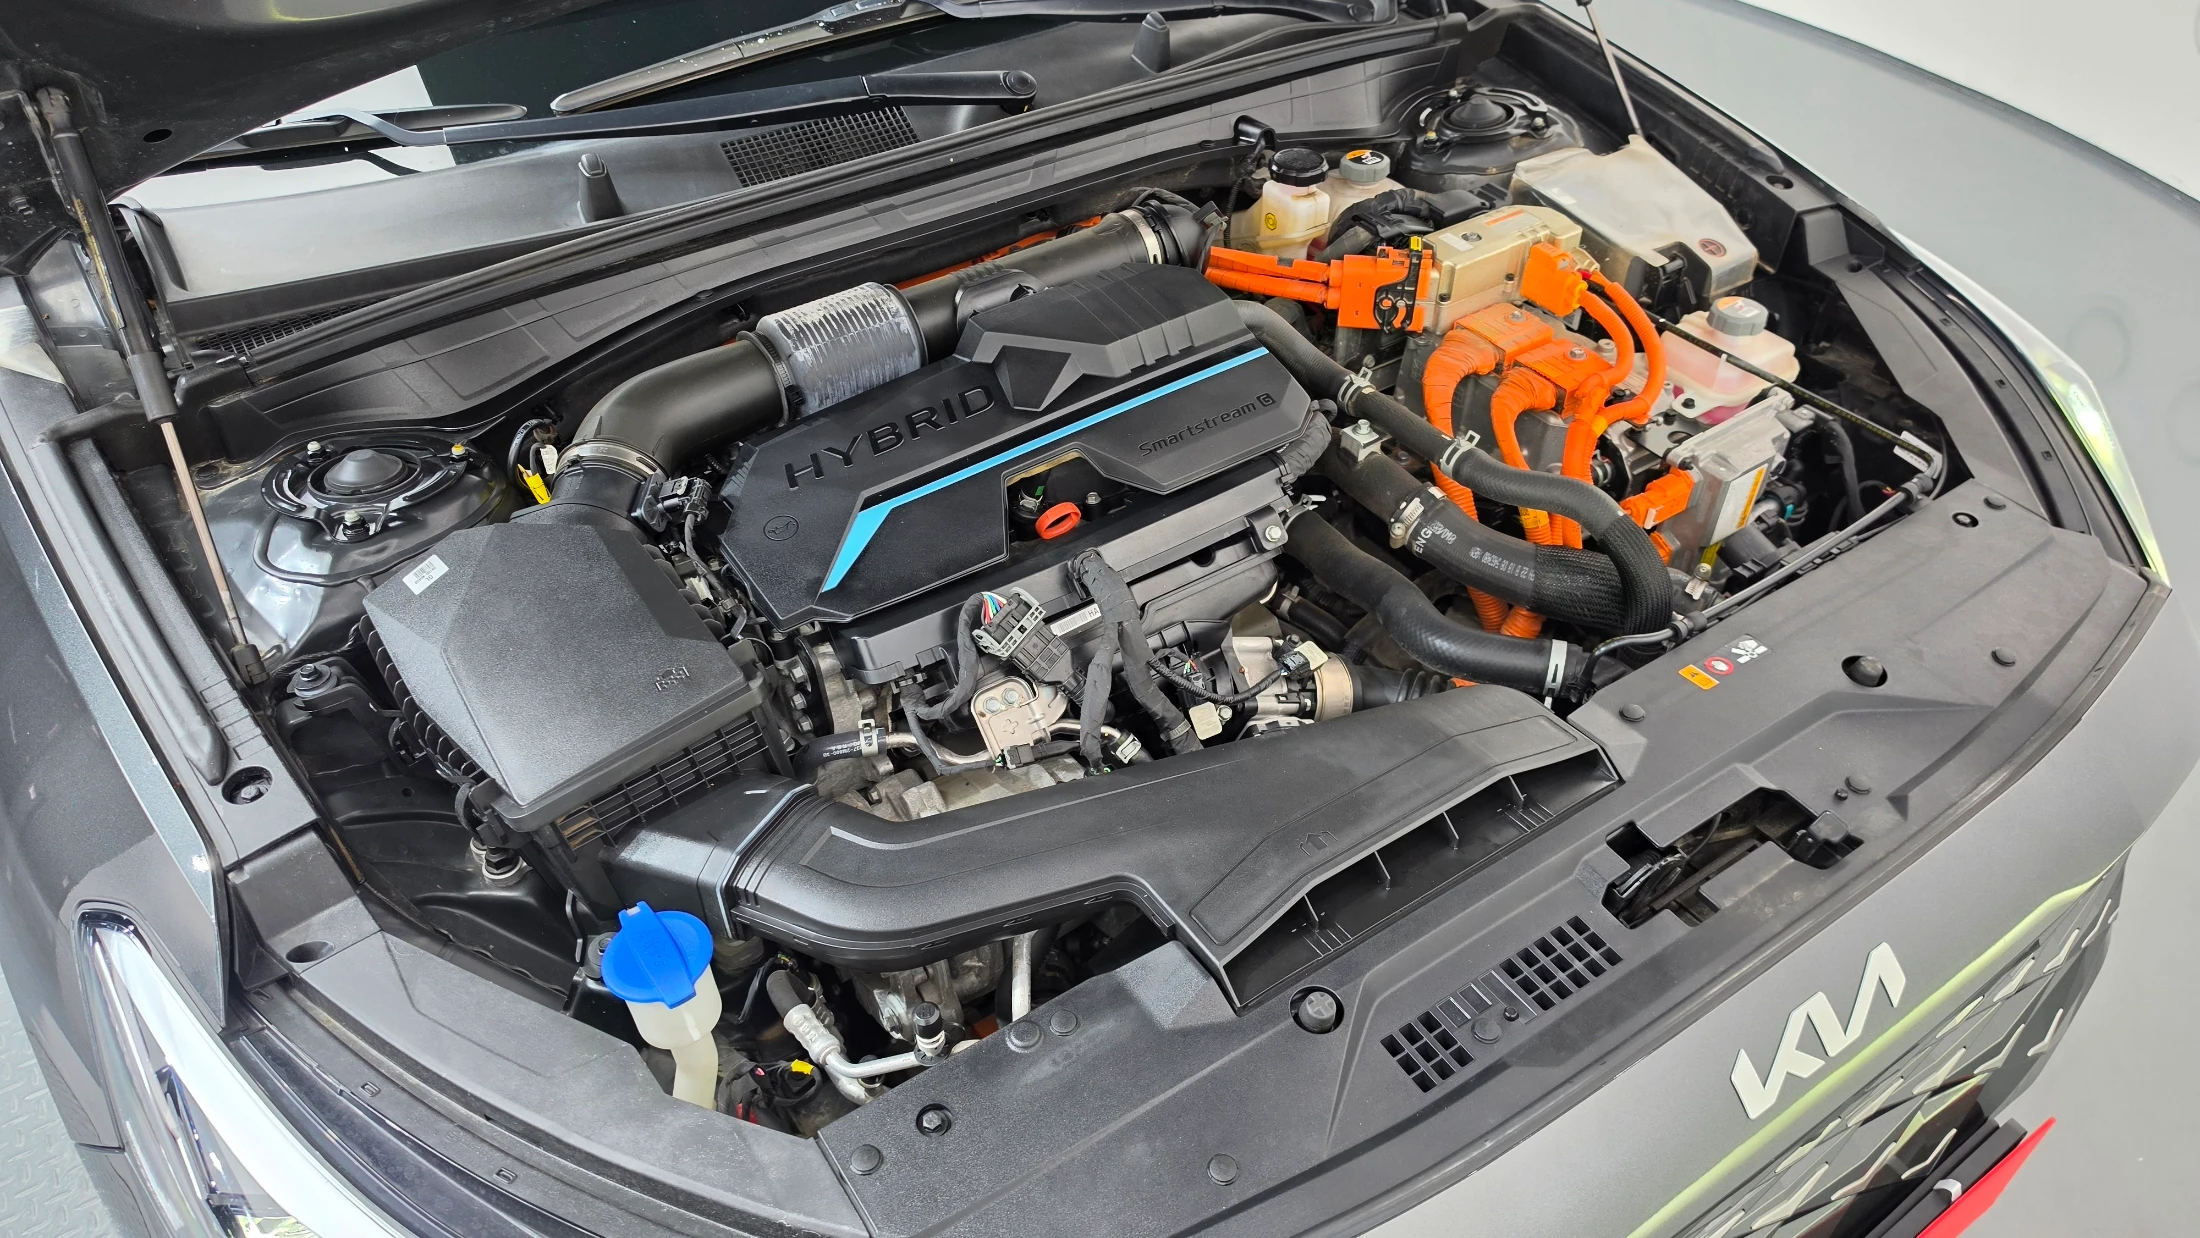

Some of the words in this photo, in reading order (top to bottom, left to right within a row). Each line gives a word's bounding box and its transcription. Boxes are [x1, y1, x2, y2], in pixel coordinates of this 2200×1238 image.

[784, 385, 995, 491] HYBRID
[1137, 401, 1257, 457] Smartstream
[1414, 527, 1433, 554] ENG
[1087, 607, 1100, 618] HA
[1730, 942, 1906, 1120] KIA
